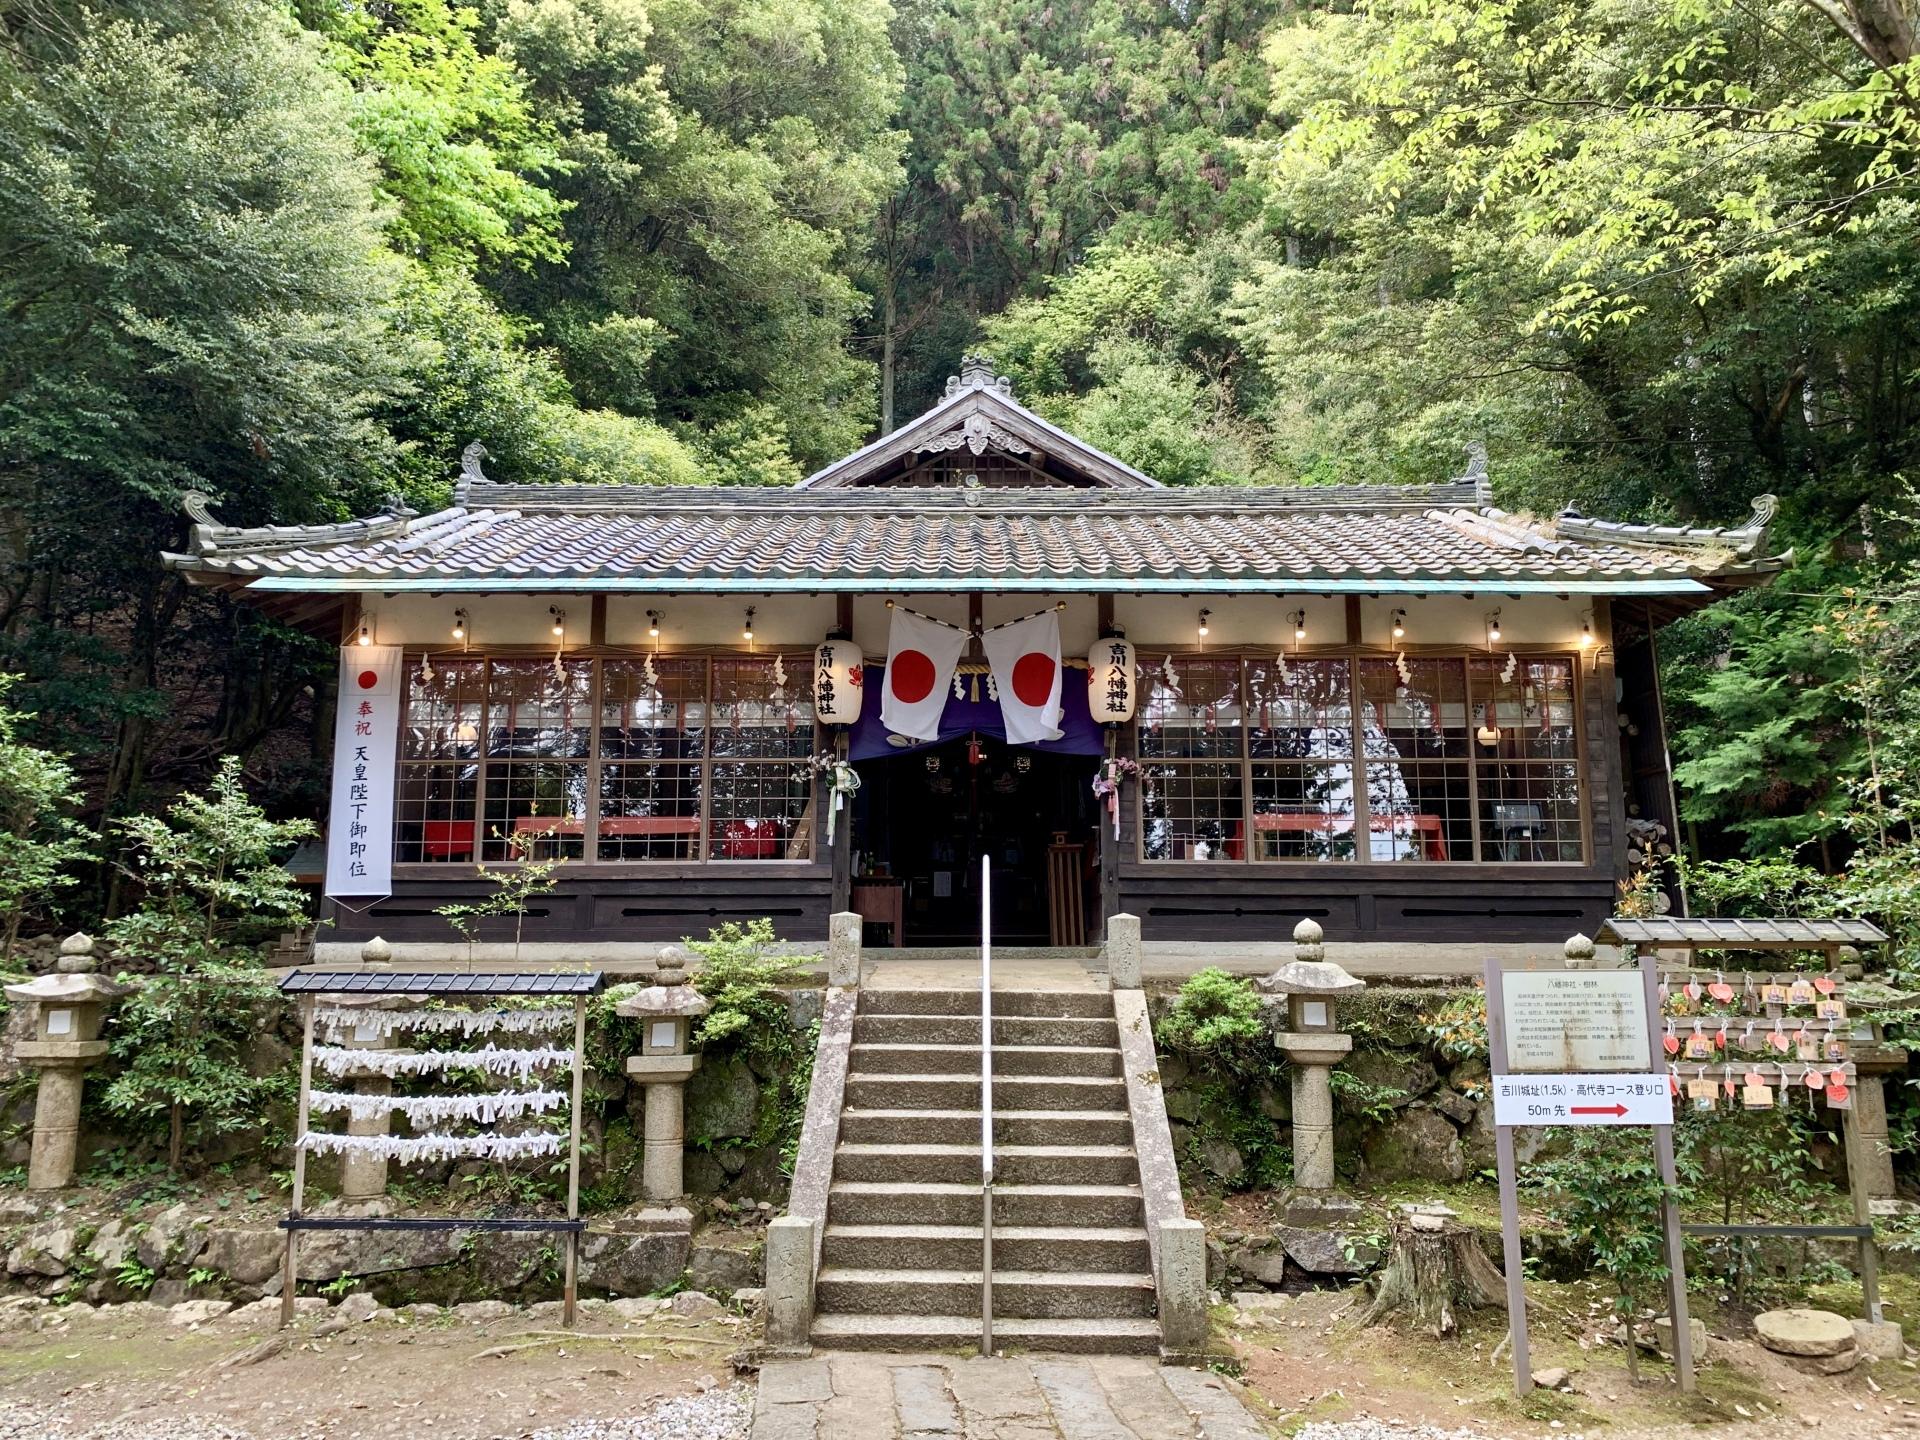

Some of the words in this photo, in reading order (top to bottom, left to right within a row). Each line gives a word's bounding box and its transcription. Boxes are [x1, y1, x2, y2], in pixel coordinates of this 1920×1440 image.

[817, 645, 837, 716] 吉川八幡神社
[1105, 643, 1128, 713] 吉川八幡神社
[354, 700, 373, 736] 奉祝
[348, 746, 370, 877] 天皇陛下御即位
[1528, 1105, 1551, 1116] 50m
[1554, 1104, 1566, 1116] 先
